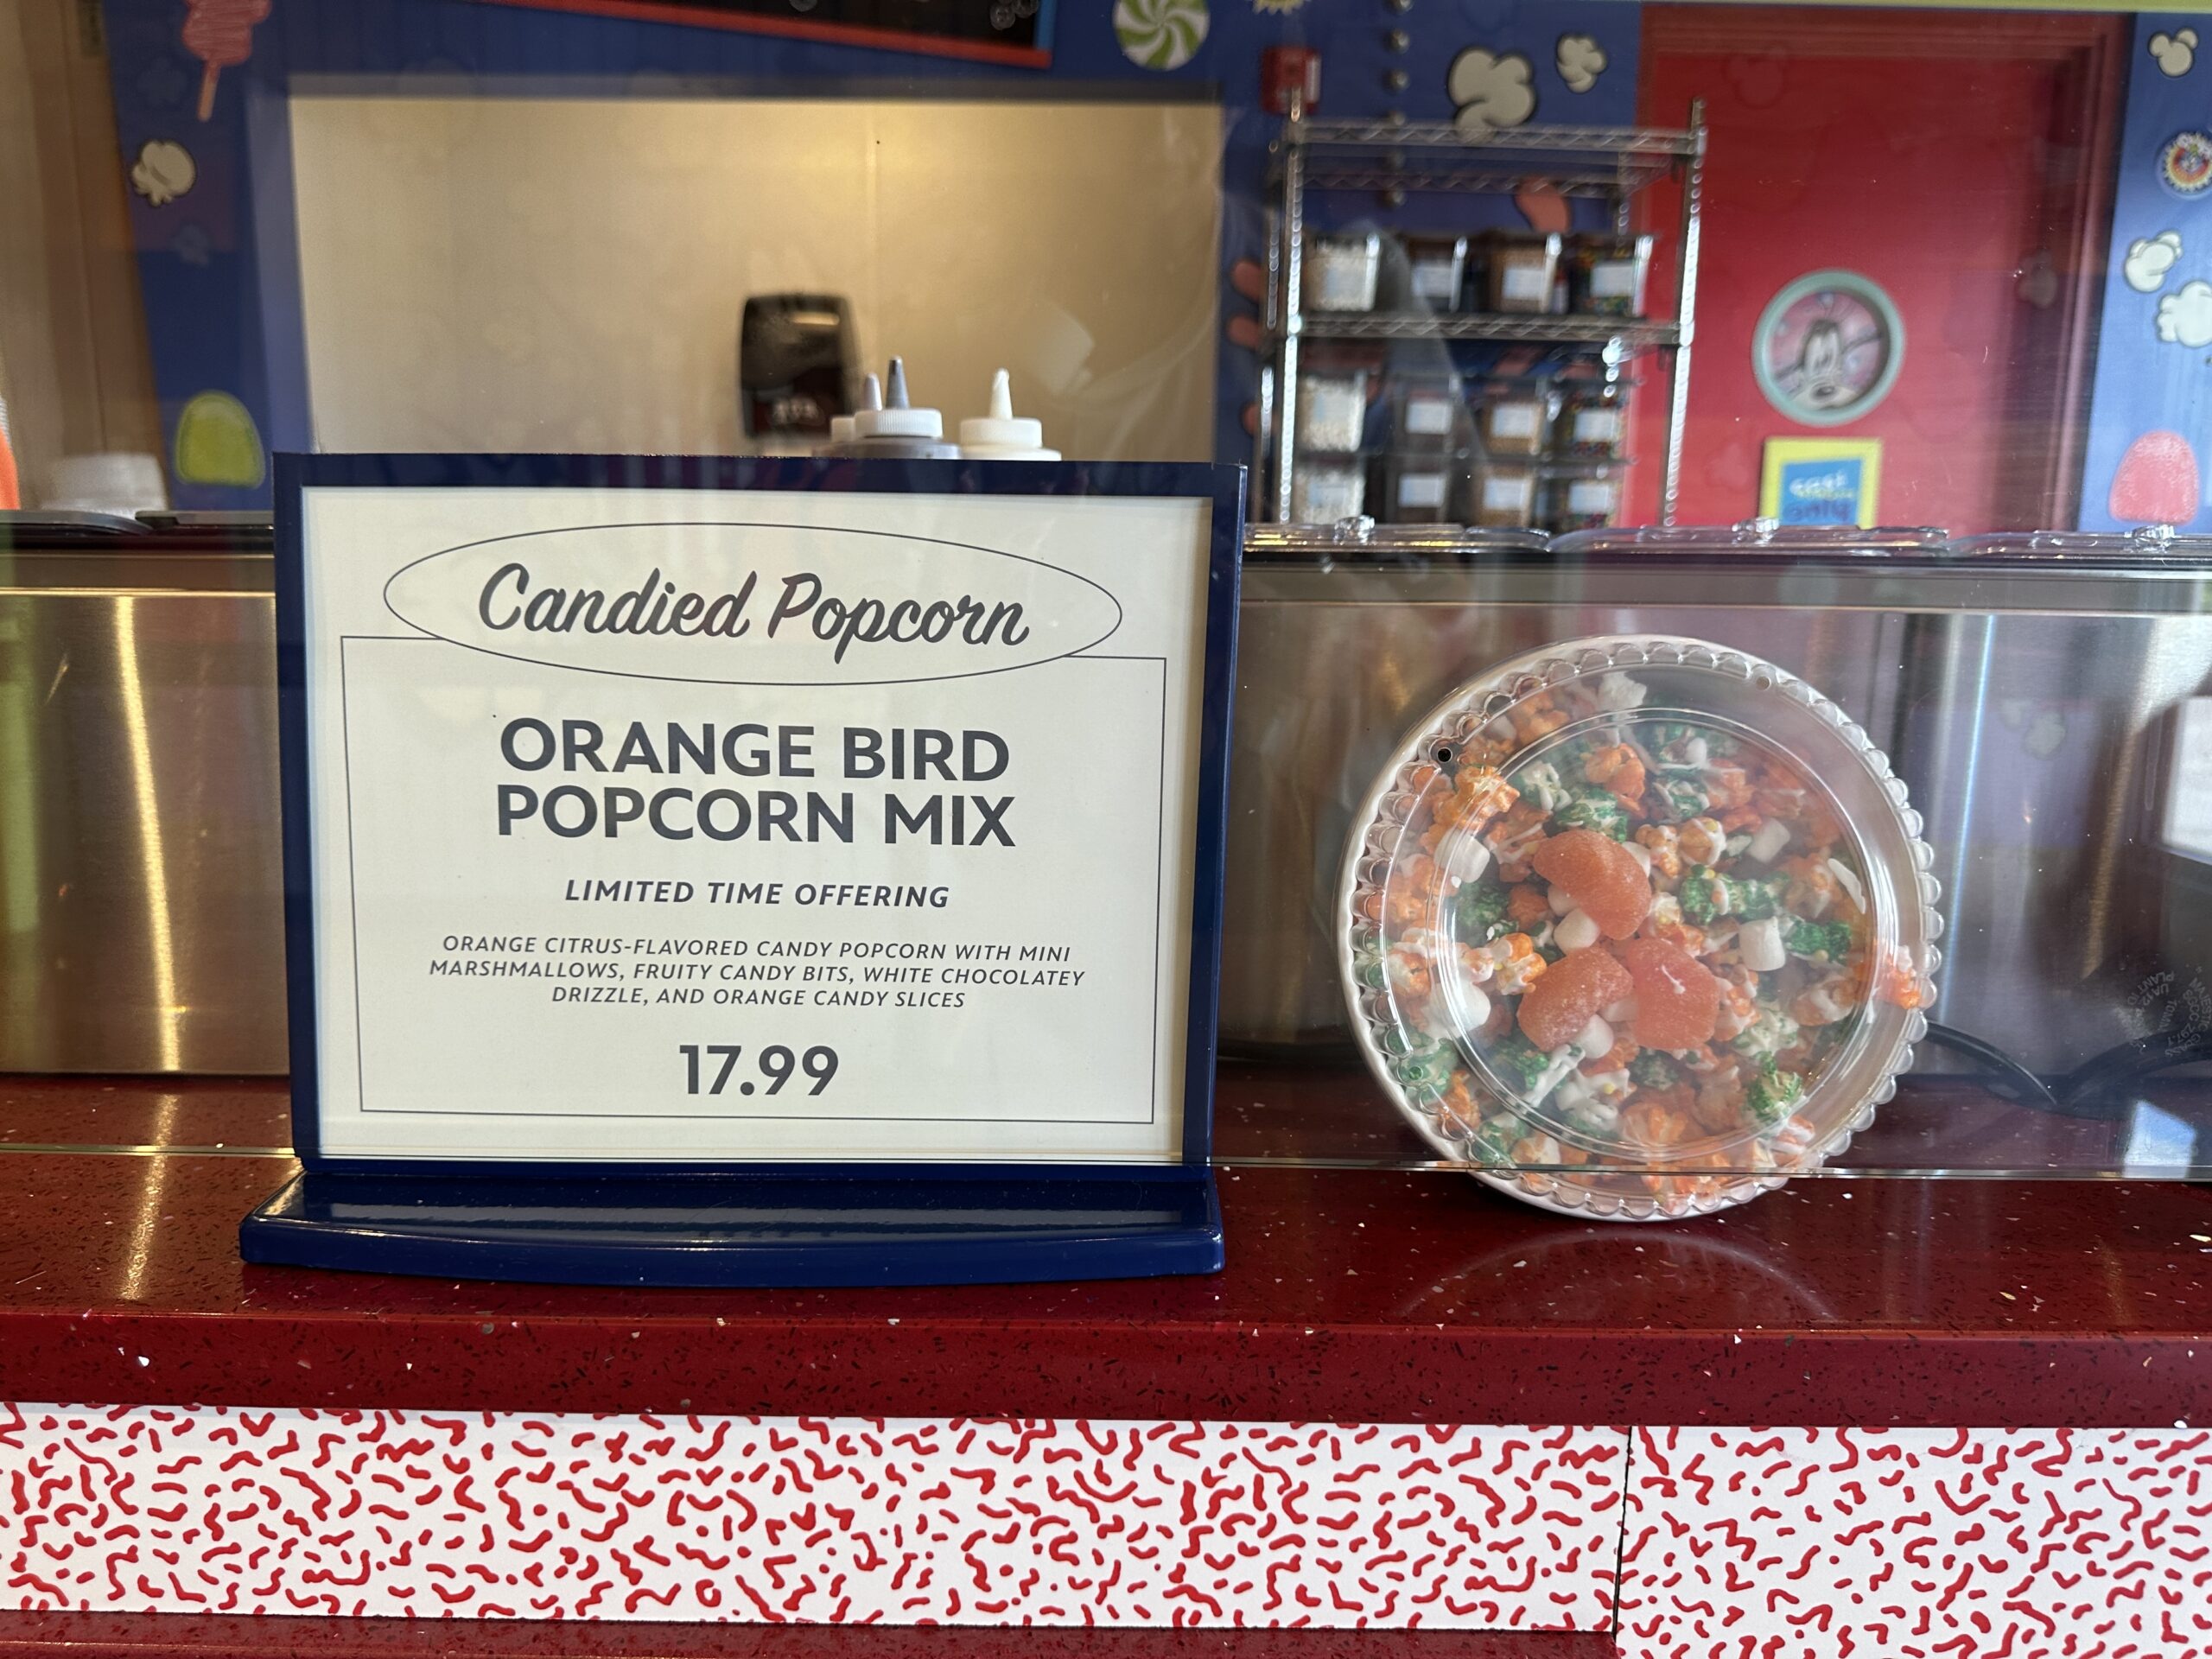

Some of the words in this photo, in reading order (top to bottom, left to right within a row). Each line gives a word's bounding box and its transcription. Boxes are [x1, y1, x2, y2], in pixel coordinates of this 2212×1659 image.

[478, 563, 752, 639] Candied
[766, 572, 1030, 665] Popcorn
[499, 717, 816, 778] ORANGE
[842, 727, 1010, 782] BIRD
[497, 784, 854, 843] POPCORN
[884, 793, 1016, 848] MIX
[564, 879, 695, 903] LIMITED
[707, 881, 784, 905] TIME
[794, 883, 950, 908] OFFERING
[442, 935, 537, 953] ORANGE
[544, 937, 748, 957] CITRUS-FLAVORED
[756, 940, 833, 957] CANDY
[839, 942, 947, 960] POPCORN
[955, 944, 1012, 961] WITH
[1019, 945, 1071, 963] MINI
[429, 959, 625, 982] MARSHMALLOWS,
[632, 963, 713, 980] FRUITY
[719, 964, 797, 982] CANDY
[802, 965, 855, 985] BITS,
[863, 966, 934, 983] WHITE
[941, 968, 1086, 987] CHOCOLATEY
[2137, 970, 2175, 994] PLANT
[551, 986, 649, 1007] DRIZZLE,
[655, 988, 705, 1004] AND
[713, 988, 807, 1006] ORANGE
[813, 989, 889, 1007] CANDY
[894, 991, 966, 1008] SLICES
[2188, 977, 2212, 1033] MAJESTIC
[679, 1044, 839, 1096] 17.99
